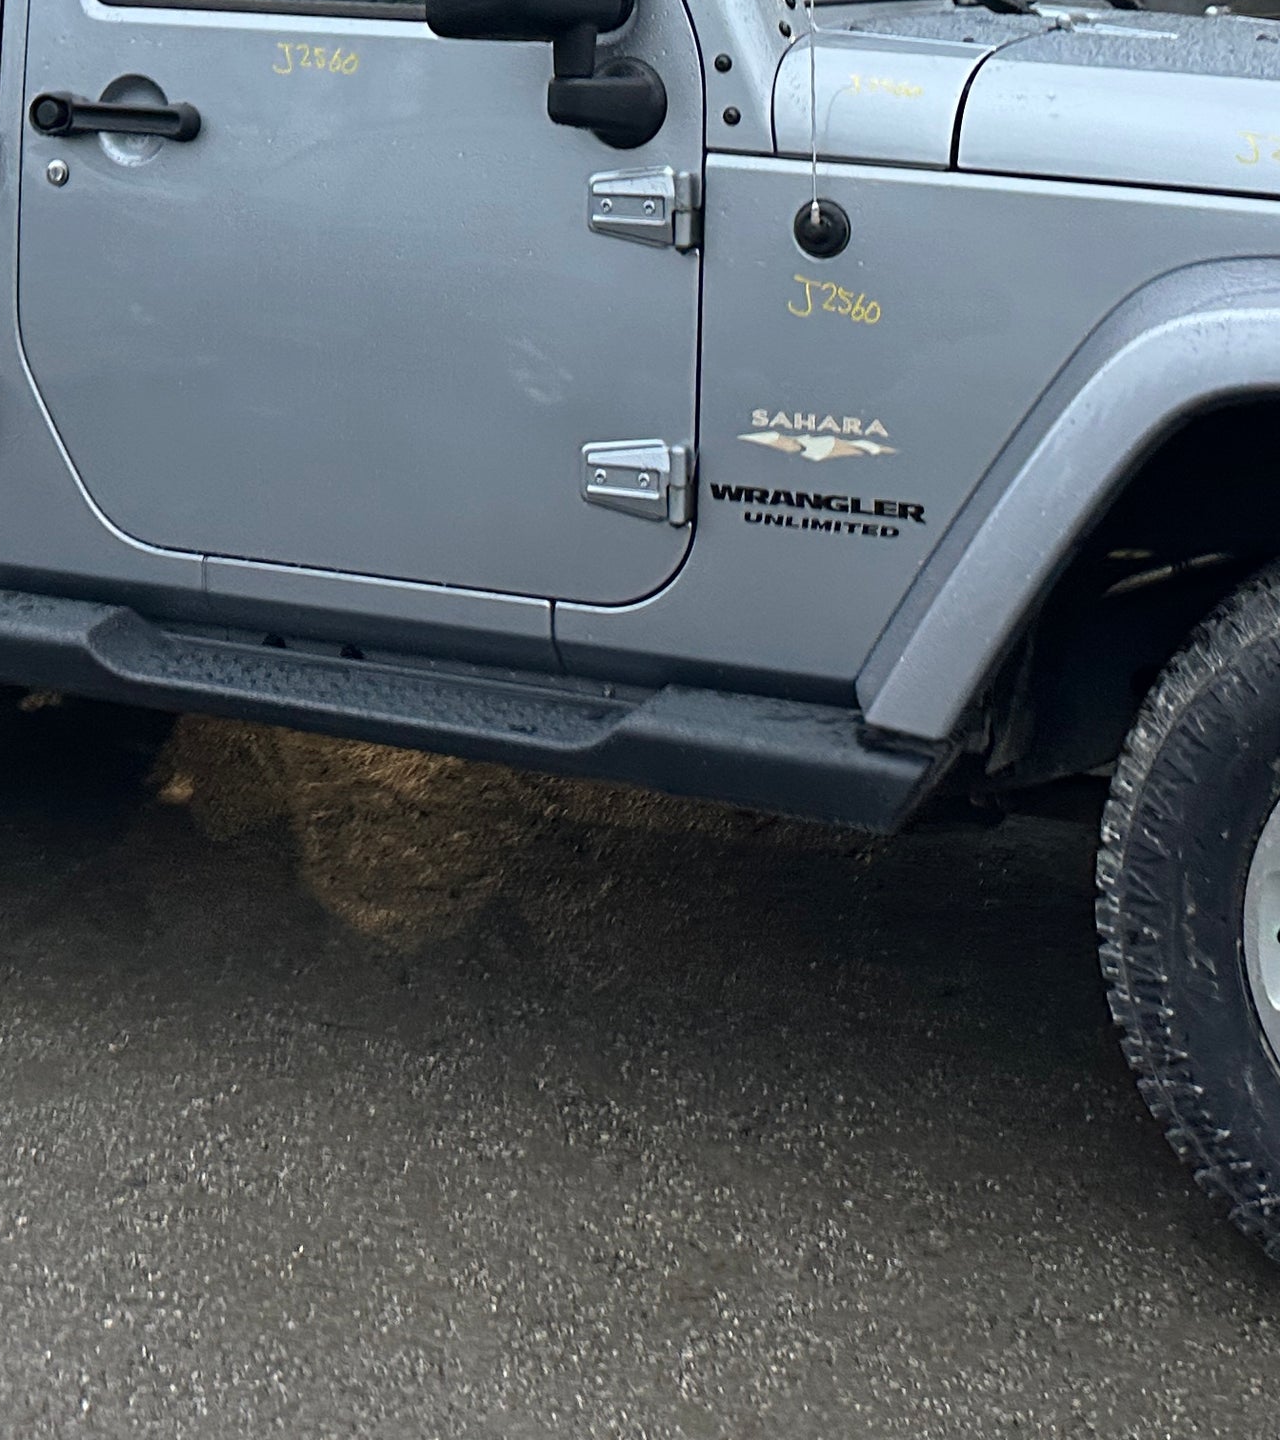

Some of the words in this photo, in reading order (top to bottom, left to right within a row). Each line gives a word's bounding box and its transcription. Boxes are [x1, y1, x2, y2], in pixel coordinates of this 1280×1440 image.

[272, 41, 360, 75] J2560
[787, 273, 882, 324] J2560
[751, 408, 889, 438] SAHARA
[709, 481, 927, 525] WRANGLER
[743, 510, 900, 539] UNLIMITED
